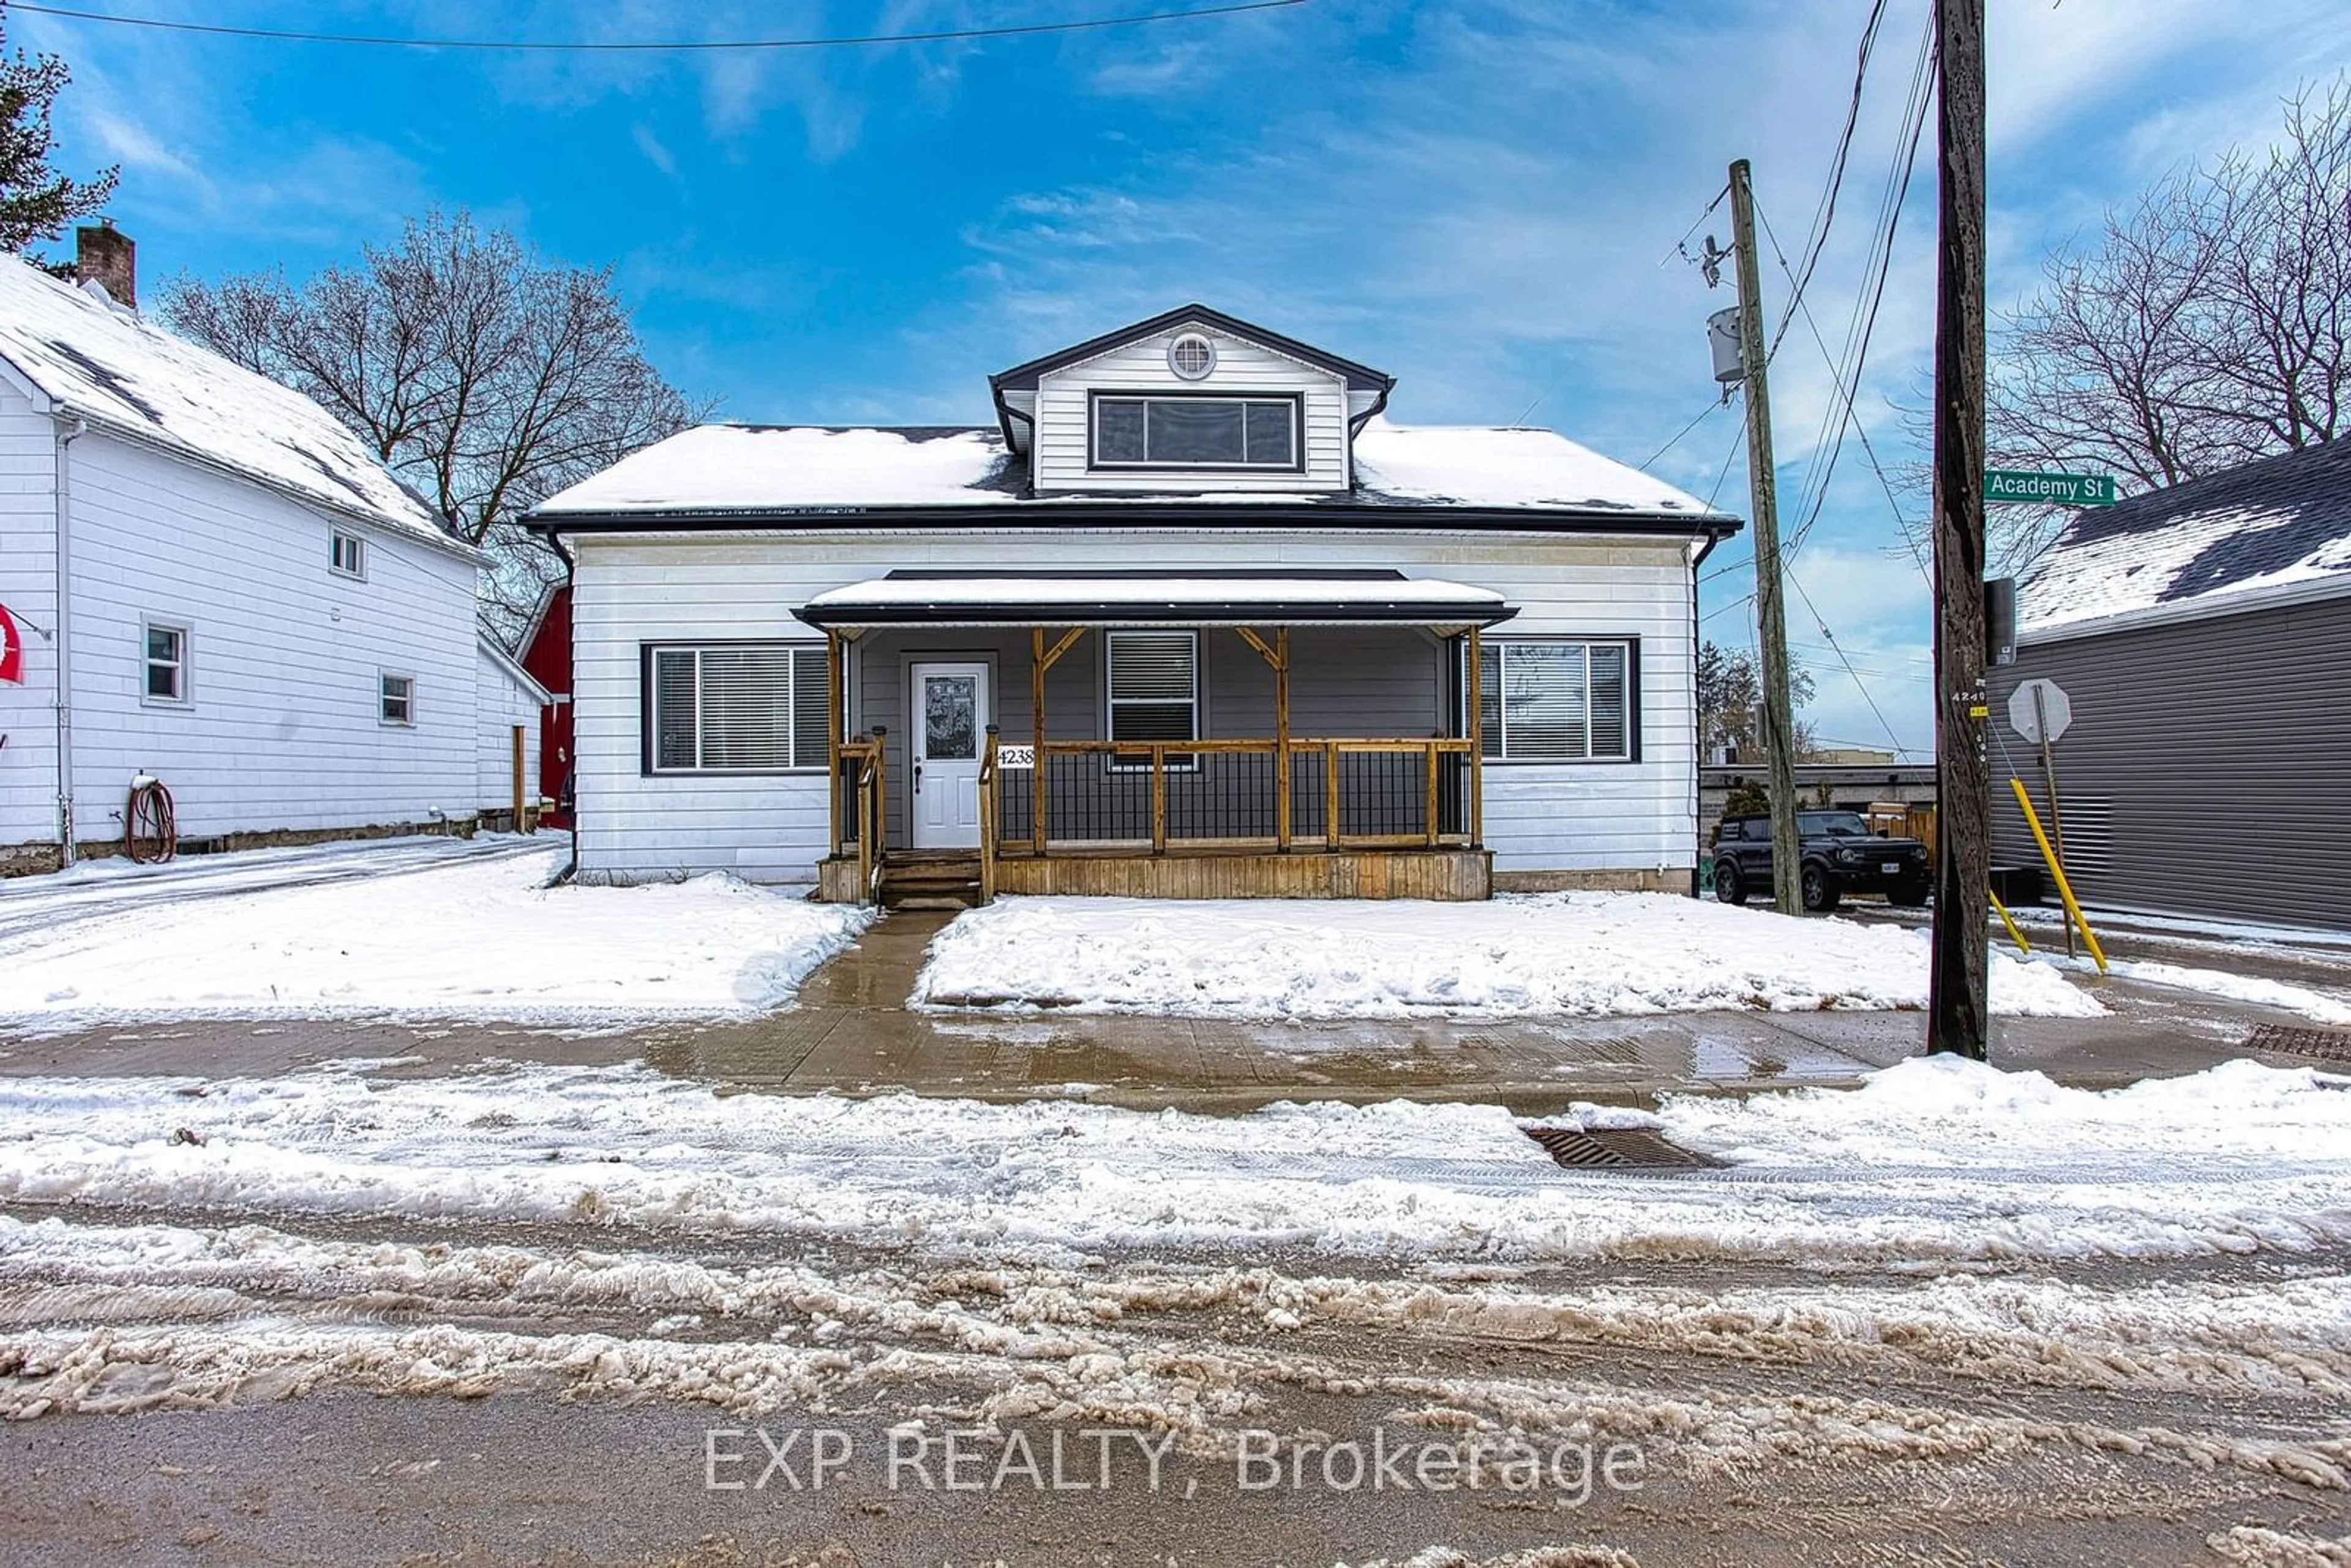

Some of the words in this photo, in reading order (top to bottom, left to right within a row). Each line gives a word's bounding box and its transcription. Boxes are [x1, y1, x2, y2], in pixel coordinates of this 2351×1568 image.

[1991, 474, 2077, 500] Academy
[2084, 478, 2104, 497] St
[999, 749, 1035, 765] 4238
